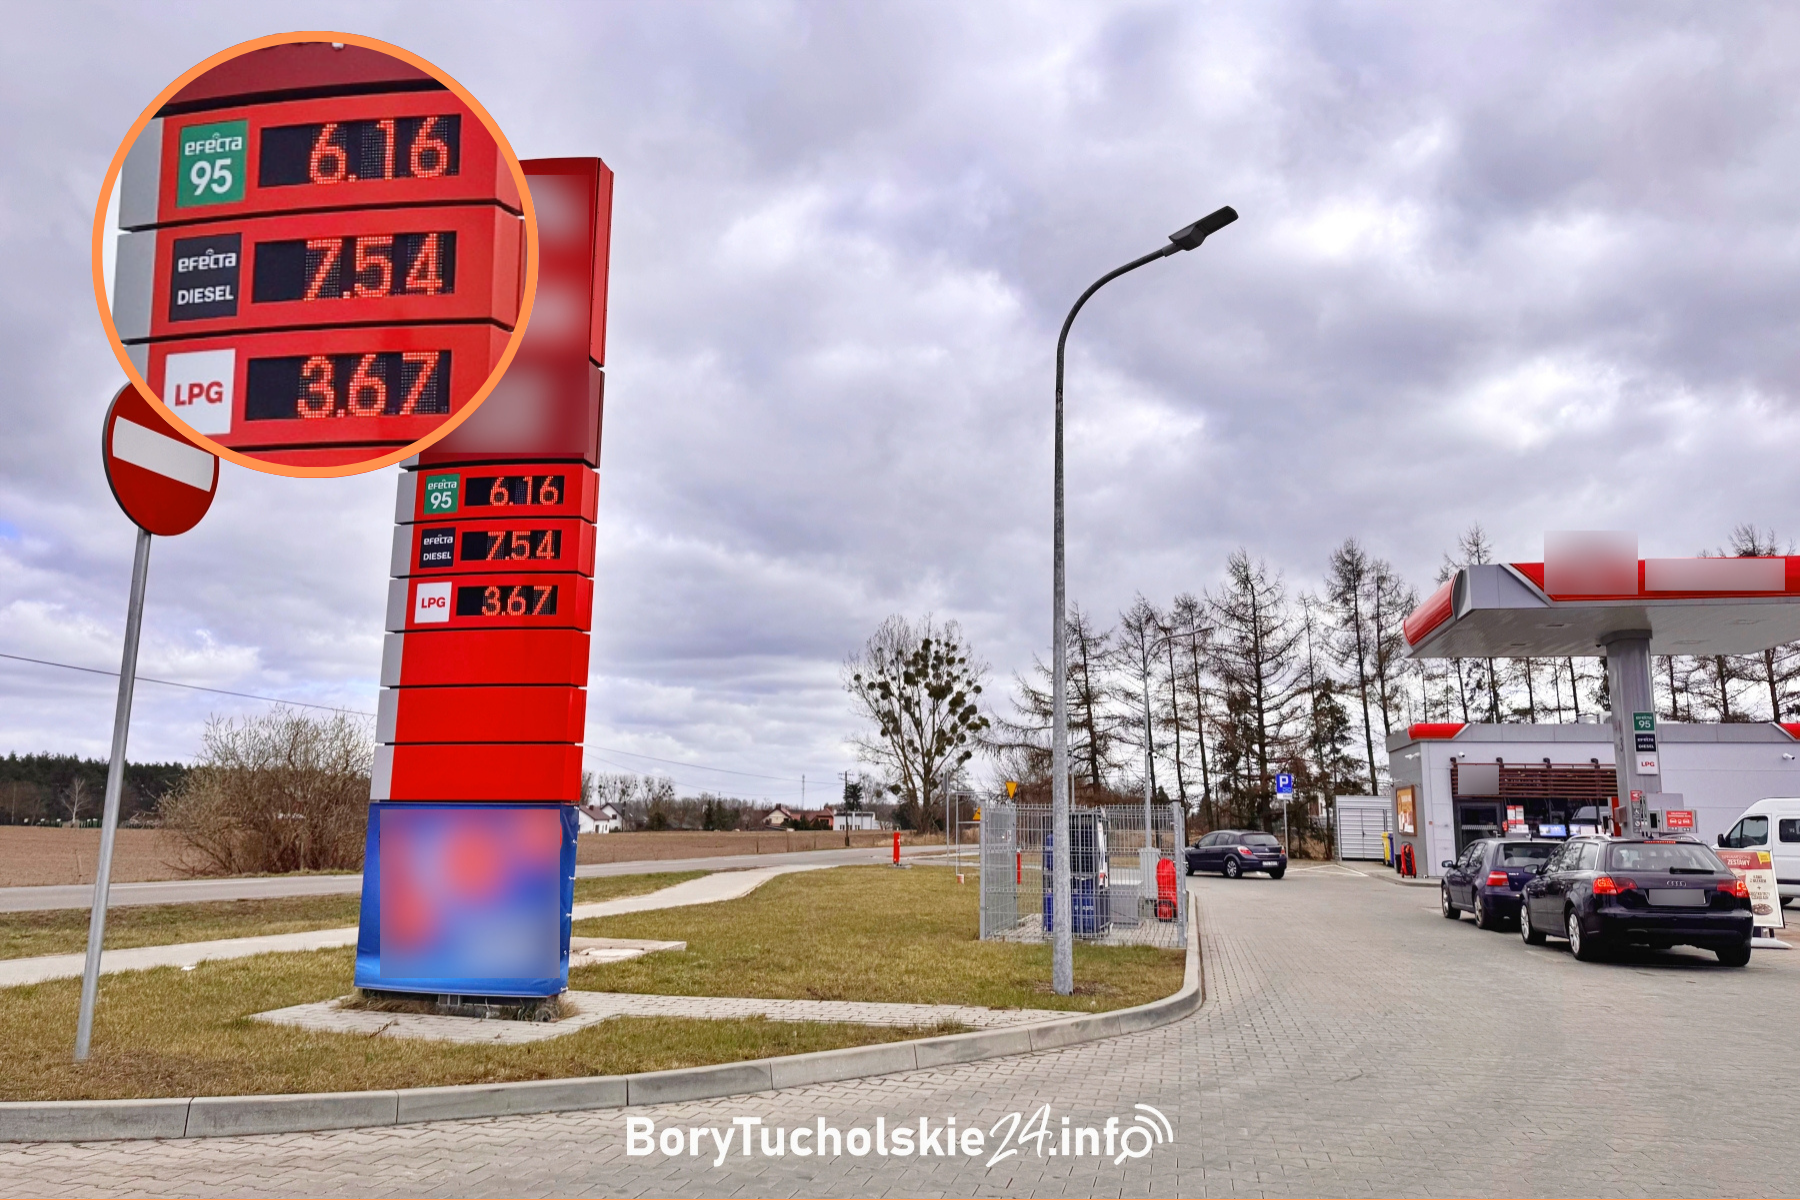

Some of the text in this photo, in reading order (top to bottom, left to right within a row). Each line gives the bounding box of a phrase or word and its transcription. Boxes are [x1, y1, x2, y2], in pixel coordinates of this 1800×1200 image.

[310, 116, 448, 185] 6.16
[190, 158, 233, 196] 95
[303, 233, 445, 302] 7.54
[177, 285, 234, 305] DIESEL
[174, 382, 224, 406] LPG
[297, 350, 441, 419] 3.67
[430, 492, 452, 509] 95
[489, 476, 559, 506] 6.16
[423, 551, 452, 561] DIESEL
[486, 530, 555, 561] 7.54
[421, 596, 447, 609] LPG
[481, 585, 553, 617] 3.67
[1638, 720, 1650, 728] 95
[1279, 775, 1289, 788] P
